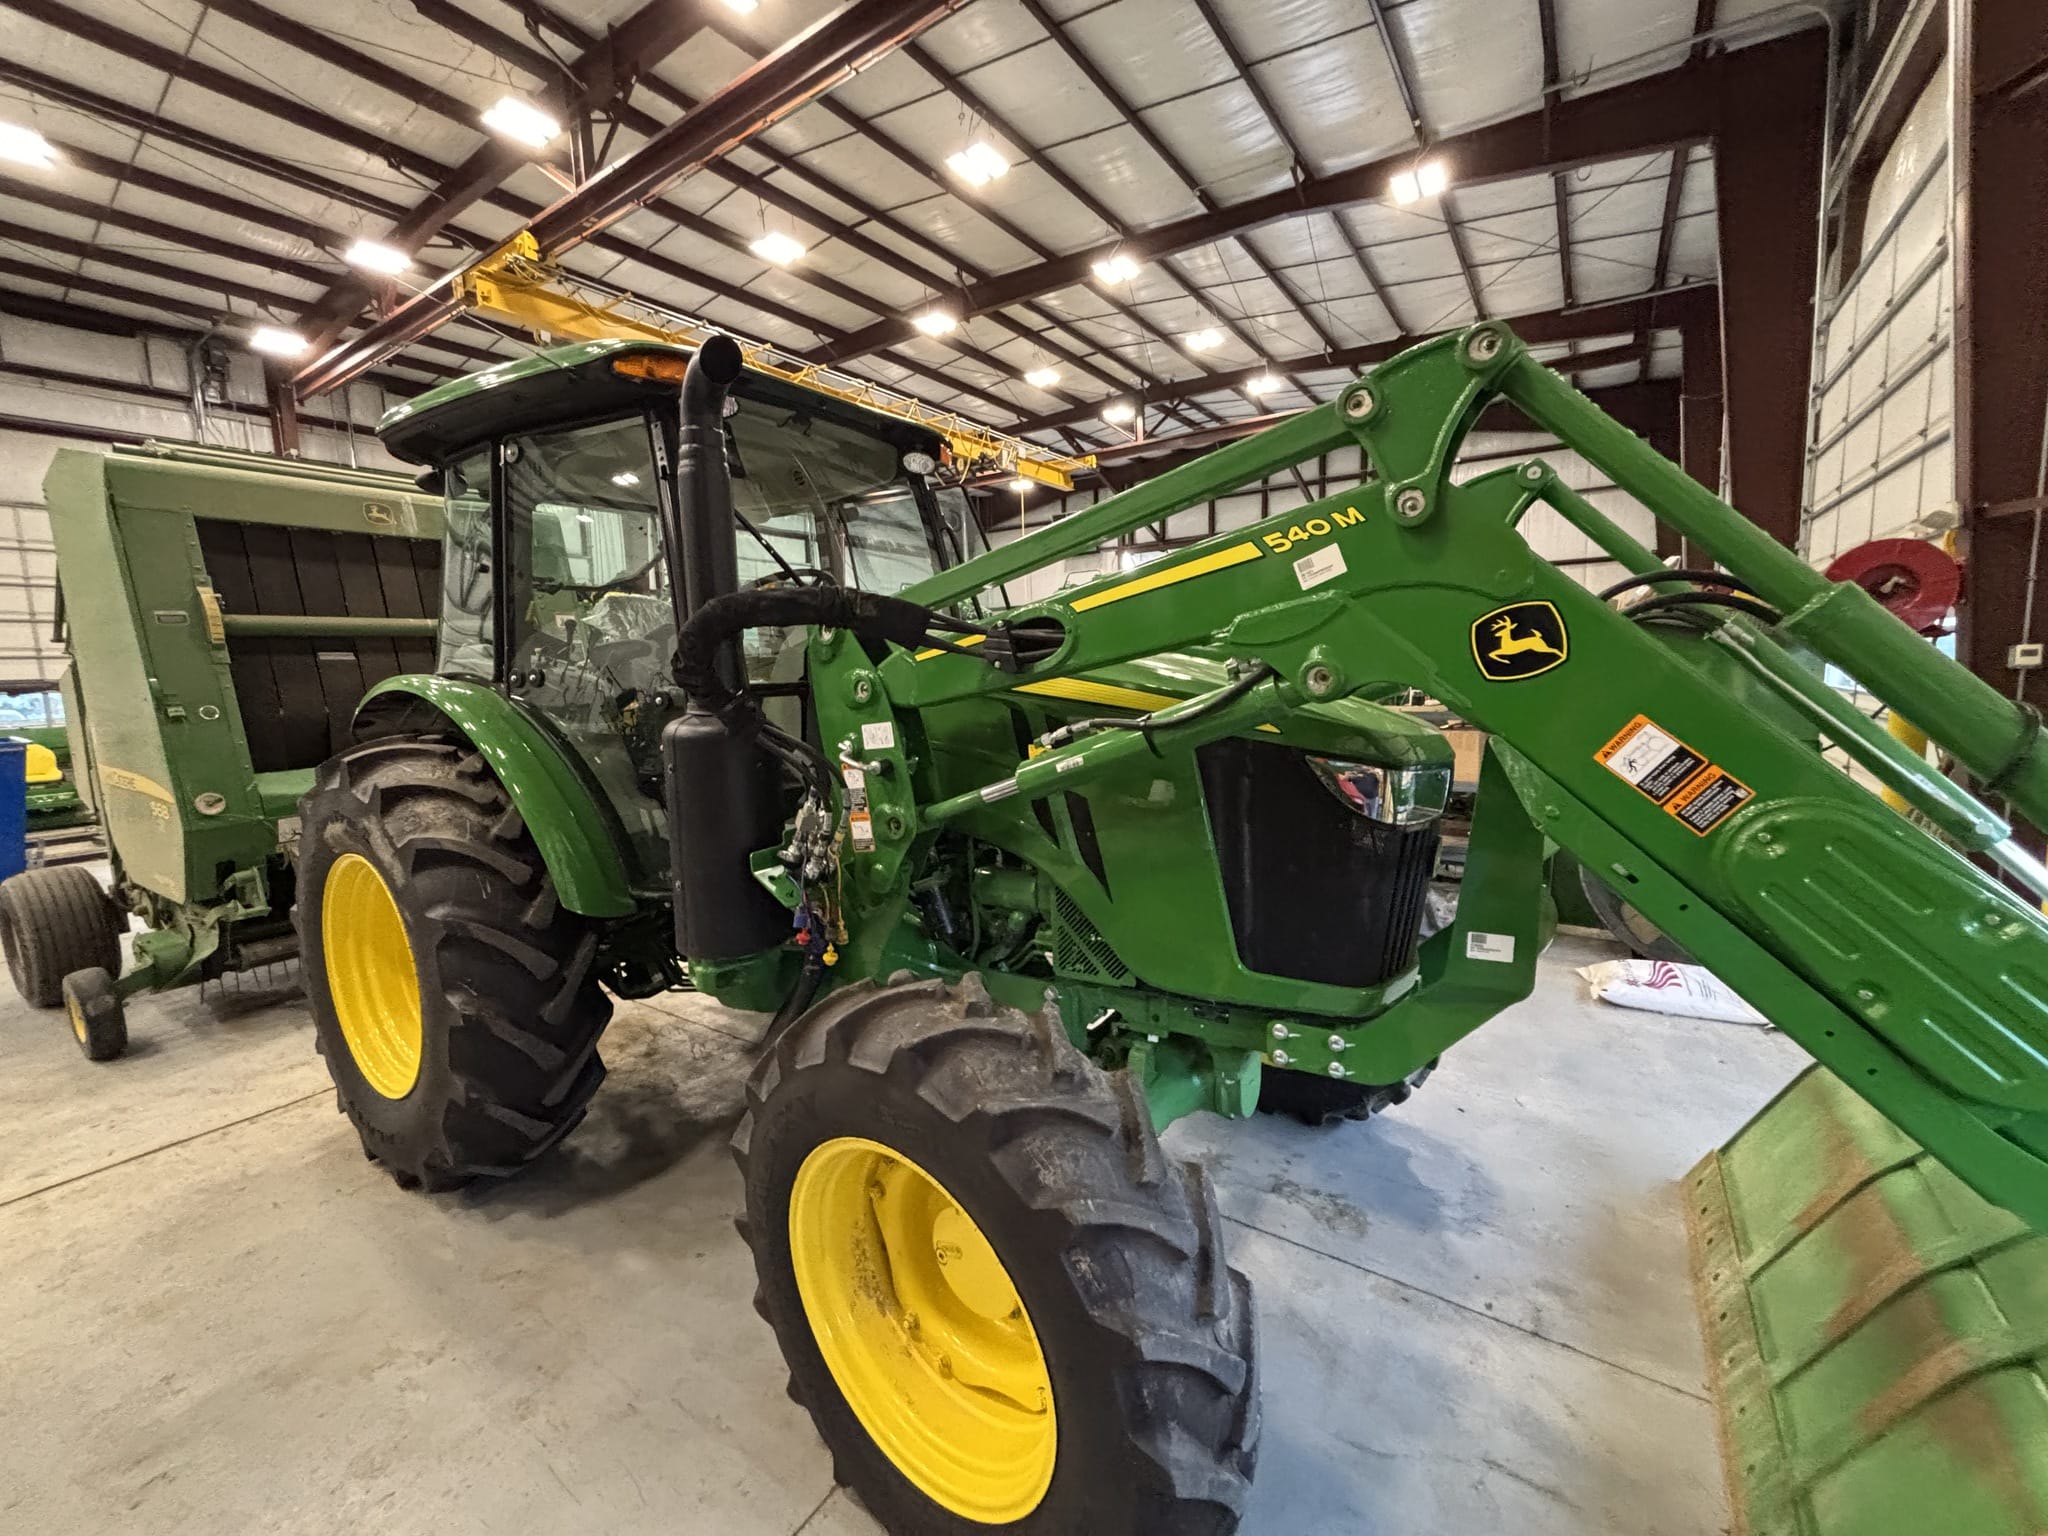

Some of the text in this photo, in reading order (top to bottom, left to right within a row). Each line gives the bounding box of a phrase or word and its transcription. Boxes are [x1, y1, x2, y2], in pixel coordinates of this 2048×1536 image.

[1262, 506, 1366, 553] 540 M
[1608, 722, 1642, 750] WARNING
[1680, 773, 1717, 801] WARNING
